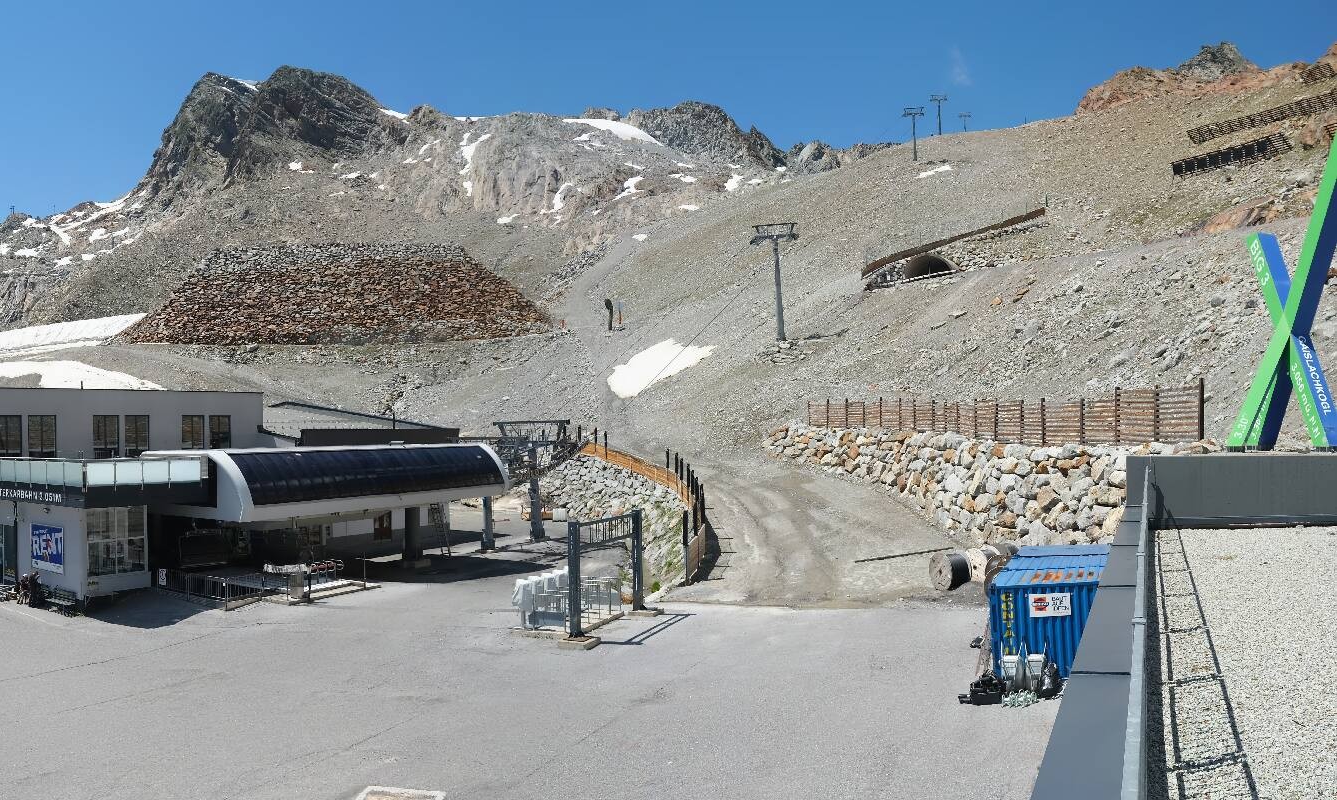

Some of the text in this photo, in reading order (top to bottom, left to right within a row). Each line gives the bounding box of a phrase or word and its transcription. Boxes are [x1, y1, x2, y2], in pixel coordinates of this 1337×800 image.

[1250, 239, 1270, 286] BIG 3
[1298, 335, 1332, 416] GAISLACHKOGL
